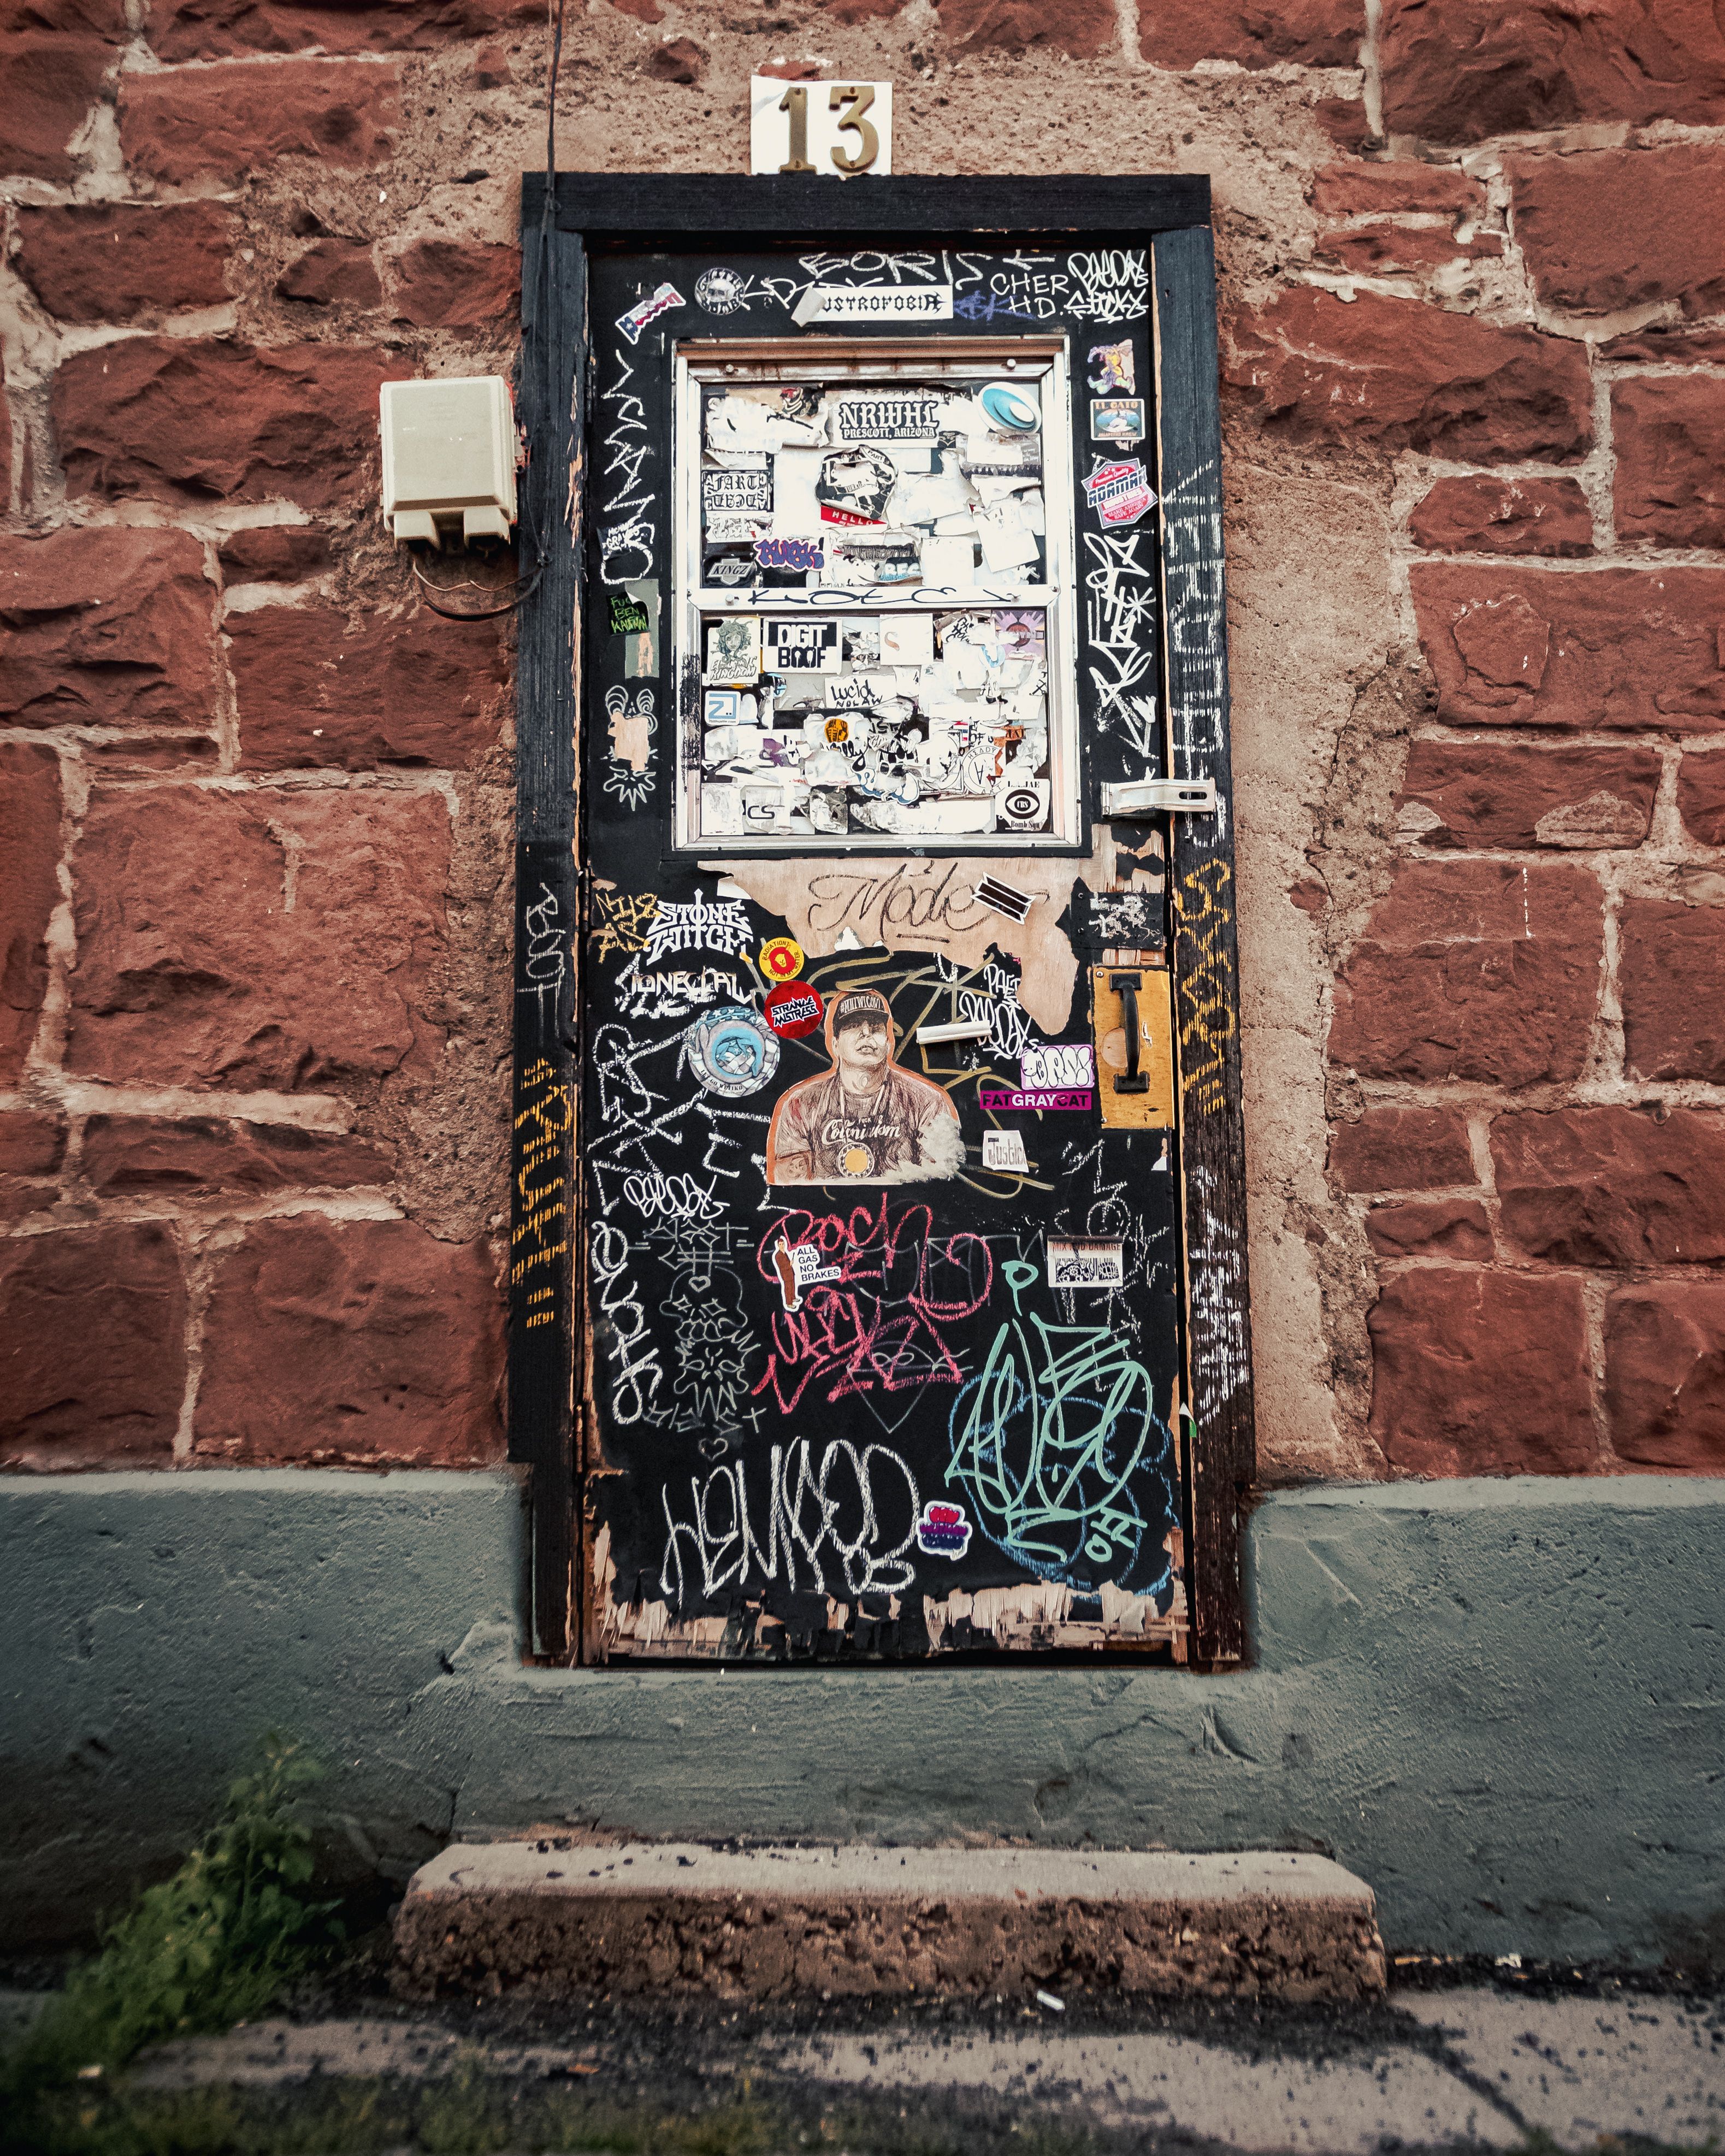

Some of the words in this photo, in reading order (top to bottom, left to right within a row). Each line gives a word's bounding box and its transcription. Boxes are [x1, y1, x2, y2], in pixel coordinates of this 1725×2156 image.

[778, 86, 879, 175] 13
[990, 273, 1069, 296] CHER
[894, 427, 935, 438] ARIZONA
[714, 475, 758, 490] FART
[831, 511, 873, 525] HELLO
[713, 564, 748, 576] KINGZ
[615, 607, 640, 619] BEN
[778, 624, 828, 647] DIGIT
[778, 647, 827, 668] BOOF
[1017, 800, 1029, 808] CBS
[1011, 820, 1027, 829] Bomb
[647, 896, 753, 935] STONE
[769, 968, 778, 977] NOT
[797, 1246, 816, 1256] ALL
[798, 1254, 818, 1264] GAS
[800, 1264, 814, 1273] NO
[801, 1268, 840, 1282] BRAKES
